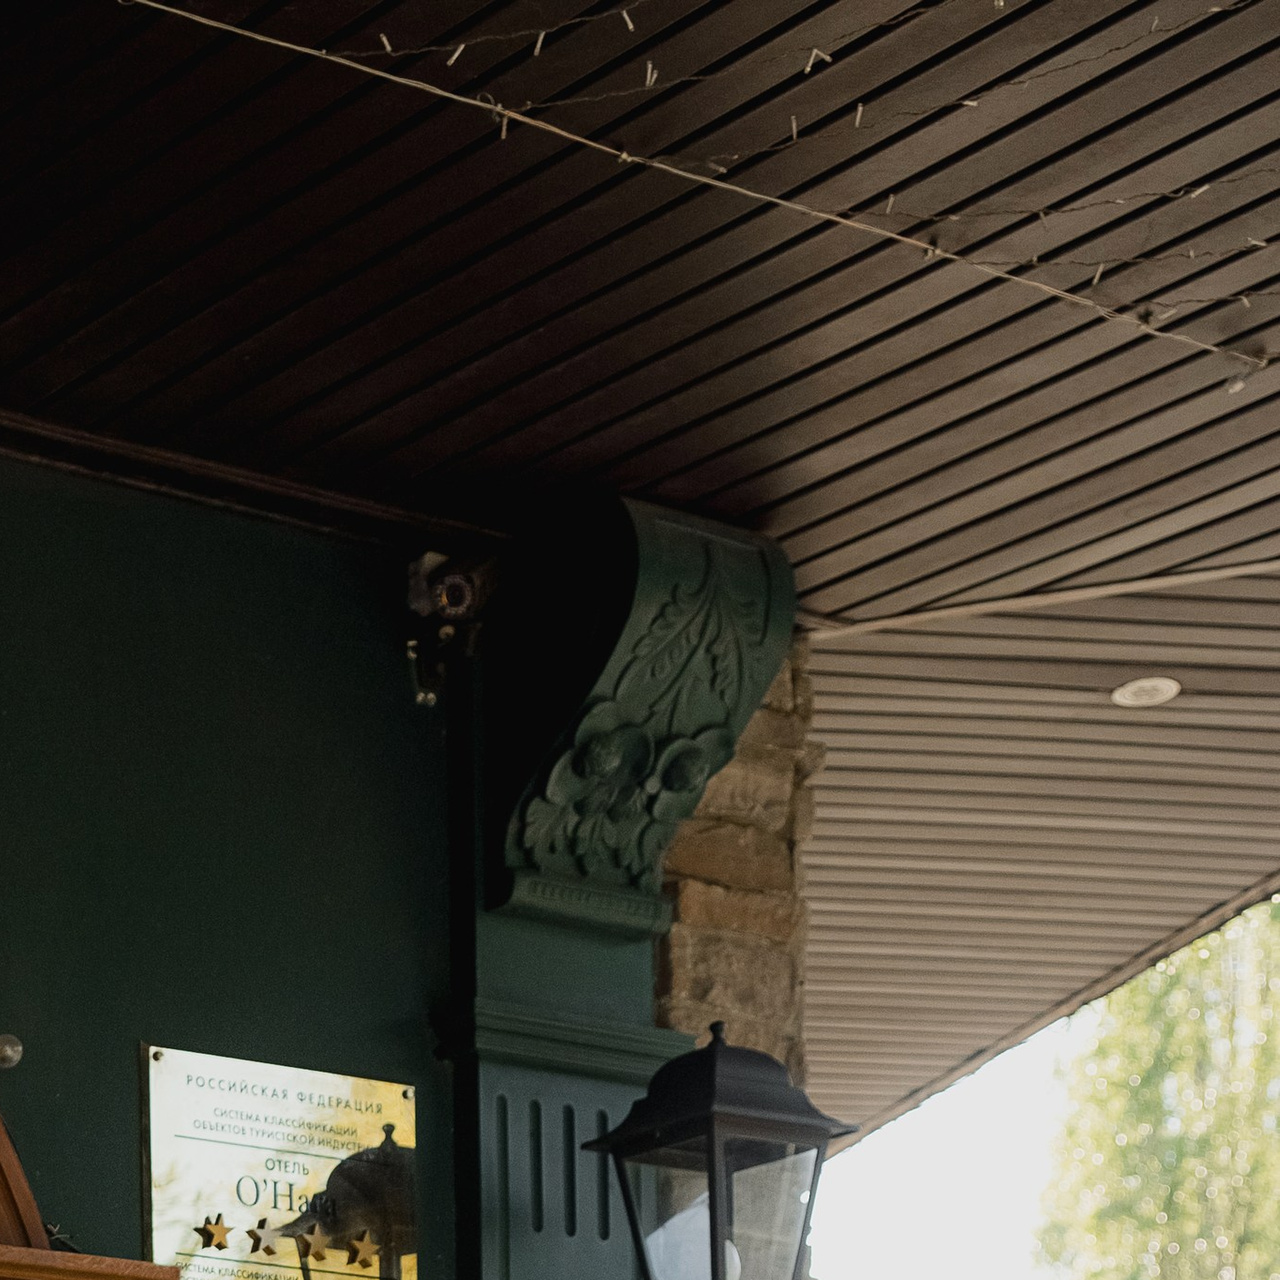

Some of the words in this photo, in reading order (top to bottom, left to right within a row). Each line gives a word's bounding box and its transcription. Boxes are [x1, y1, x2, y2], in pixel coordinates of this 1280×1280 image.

[186, 1073, 289, 1100] РОССИЙСКАЯ
[296, 1090, 384, 1116] ФЕДЕРАЦИЯ
[192, 1118, 248, 1136] ОБЪЕКТОВ
[248, 1126, 316, 1146] ТУРИСТСКОЙ
[212, 1106, 262, 1124] СИСТЕМА
[263, 1113, 359, 1139] КЛАССИФИКАЦИИ
[264, 1157, 310, 1176] ОТЕЛЬ
[174, 1260, 216, 1276] СИСТЕМА
